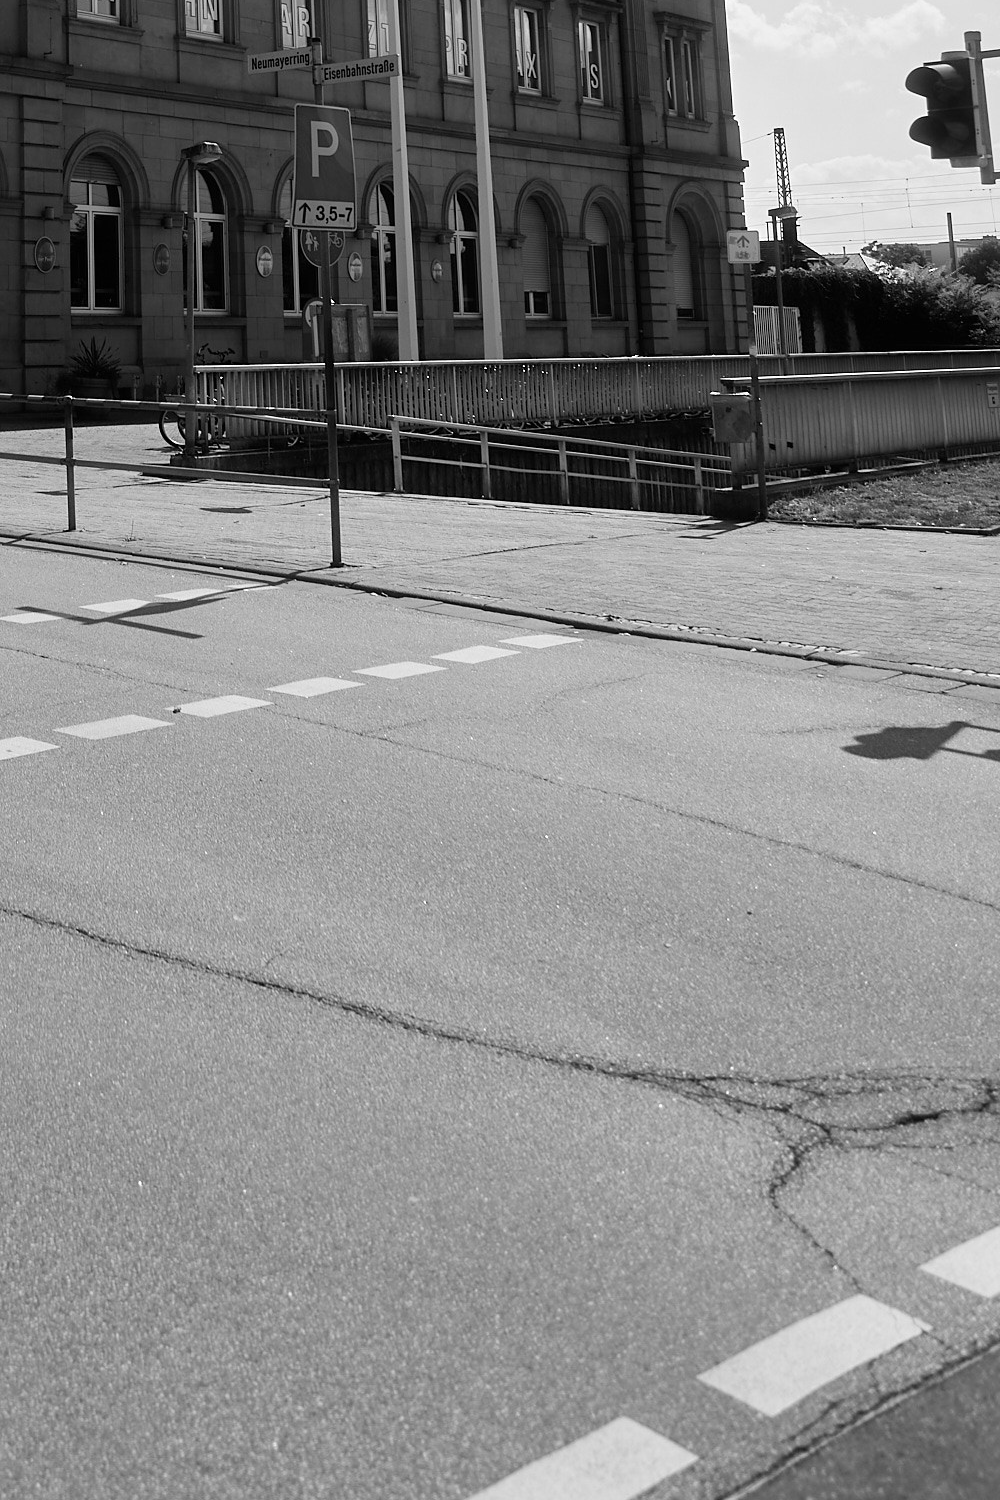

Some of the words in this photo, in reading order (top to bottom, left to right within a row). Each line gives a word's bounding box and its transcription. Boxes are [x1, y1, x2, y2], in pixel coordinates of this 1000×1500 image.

[251, 51, 310, 71] Neumayerring
[323, 59, 395, 82] Eisenbahnstraße
[310, 120, 339, 178] P
[315, 205, 353, 224] 3,5-7
